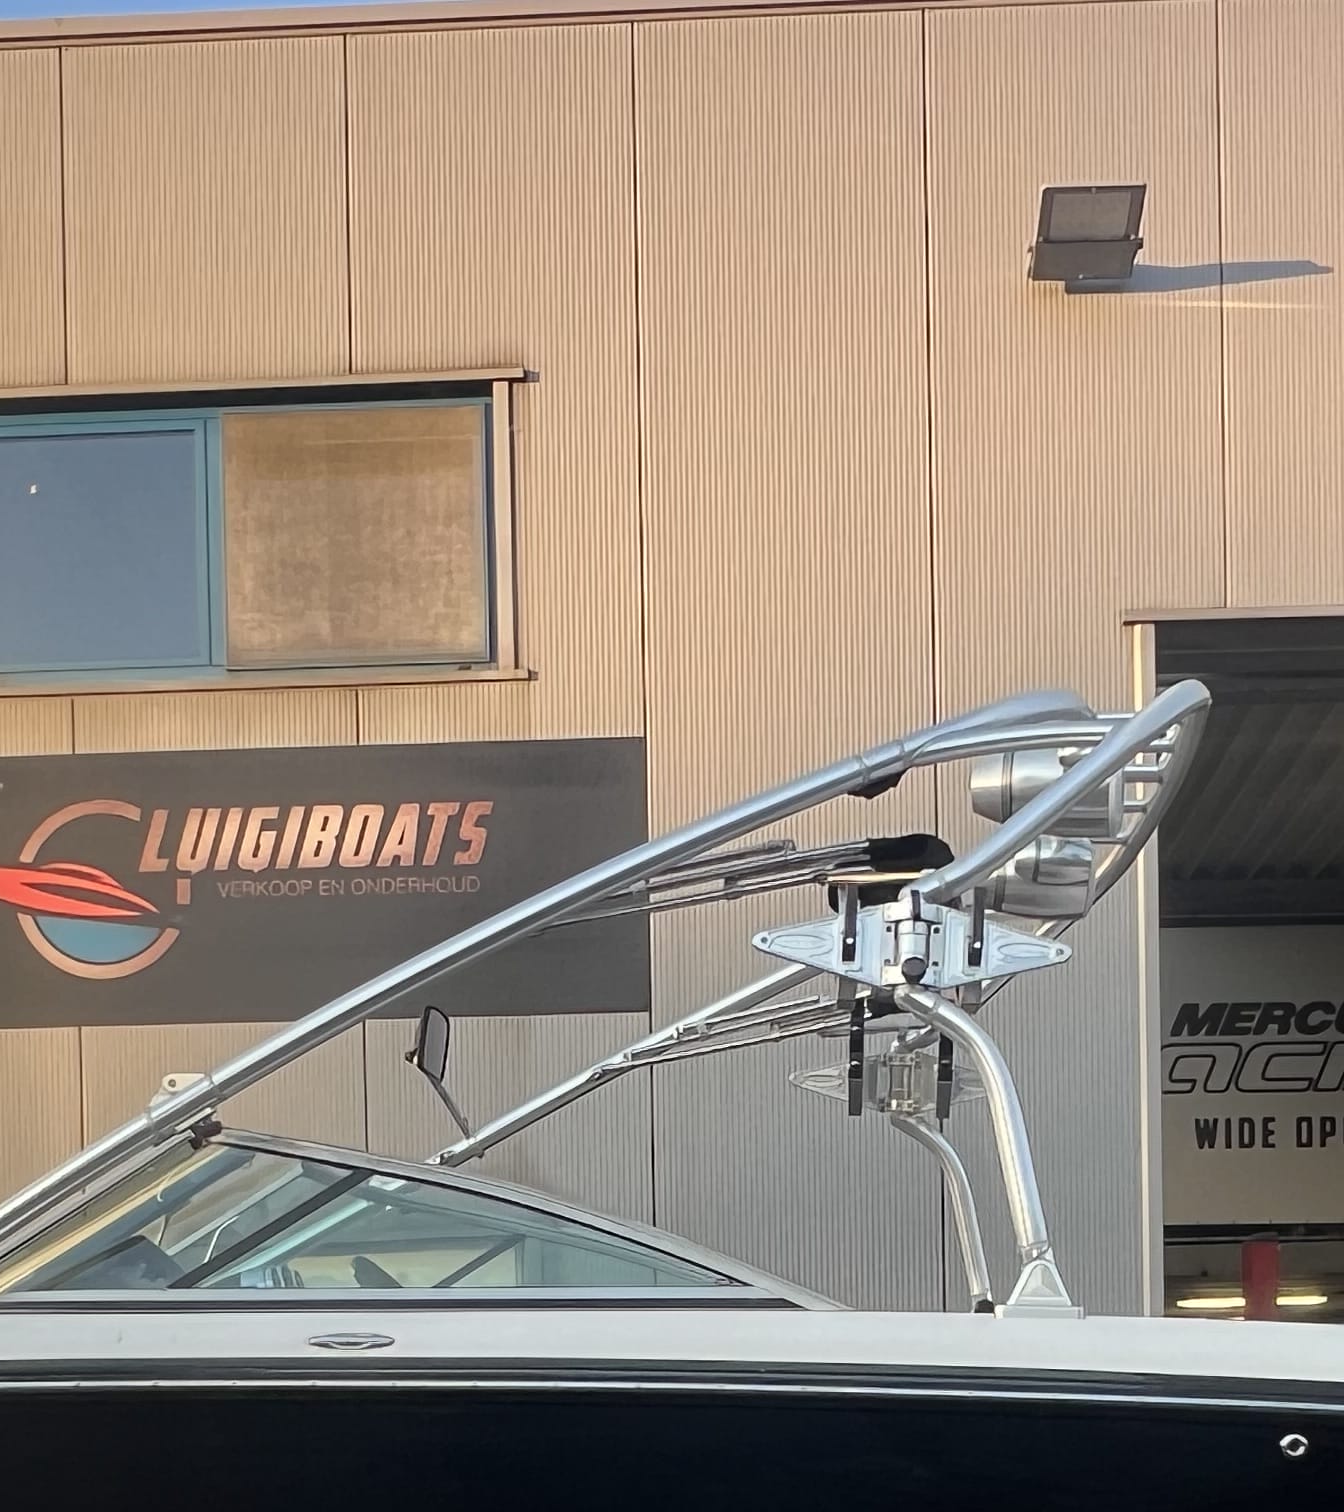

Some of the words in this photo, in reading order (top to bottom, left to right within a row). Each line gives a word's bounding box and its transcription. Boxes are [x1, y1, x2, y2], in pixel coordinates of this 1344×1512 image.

[138, 801, 494, 876] LUIGIBOATS
[217, 878, 313, 899] VERKOOP
[319, 878, 345, 897] EN
[351, 875, 481, 896] ONDERHOUD
[1194, 1116, 1277, 1150] WIDE
